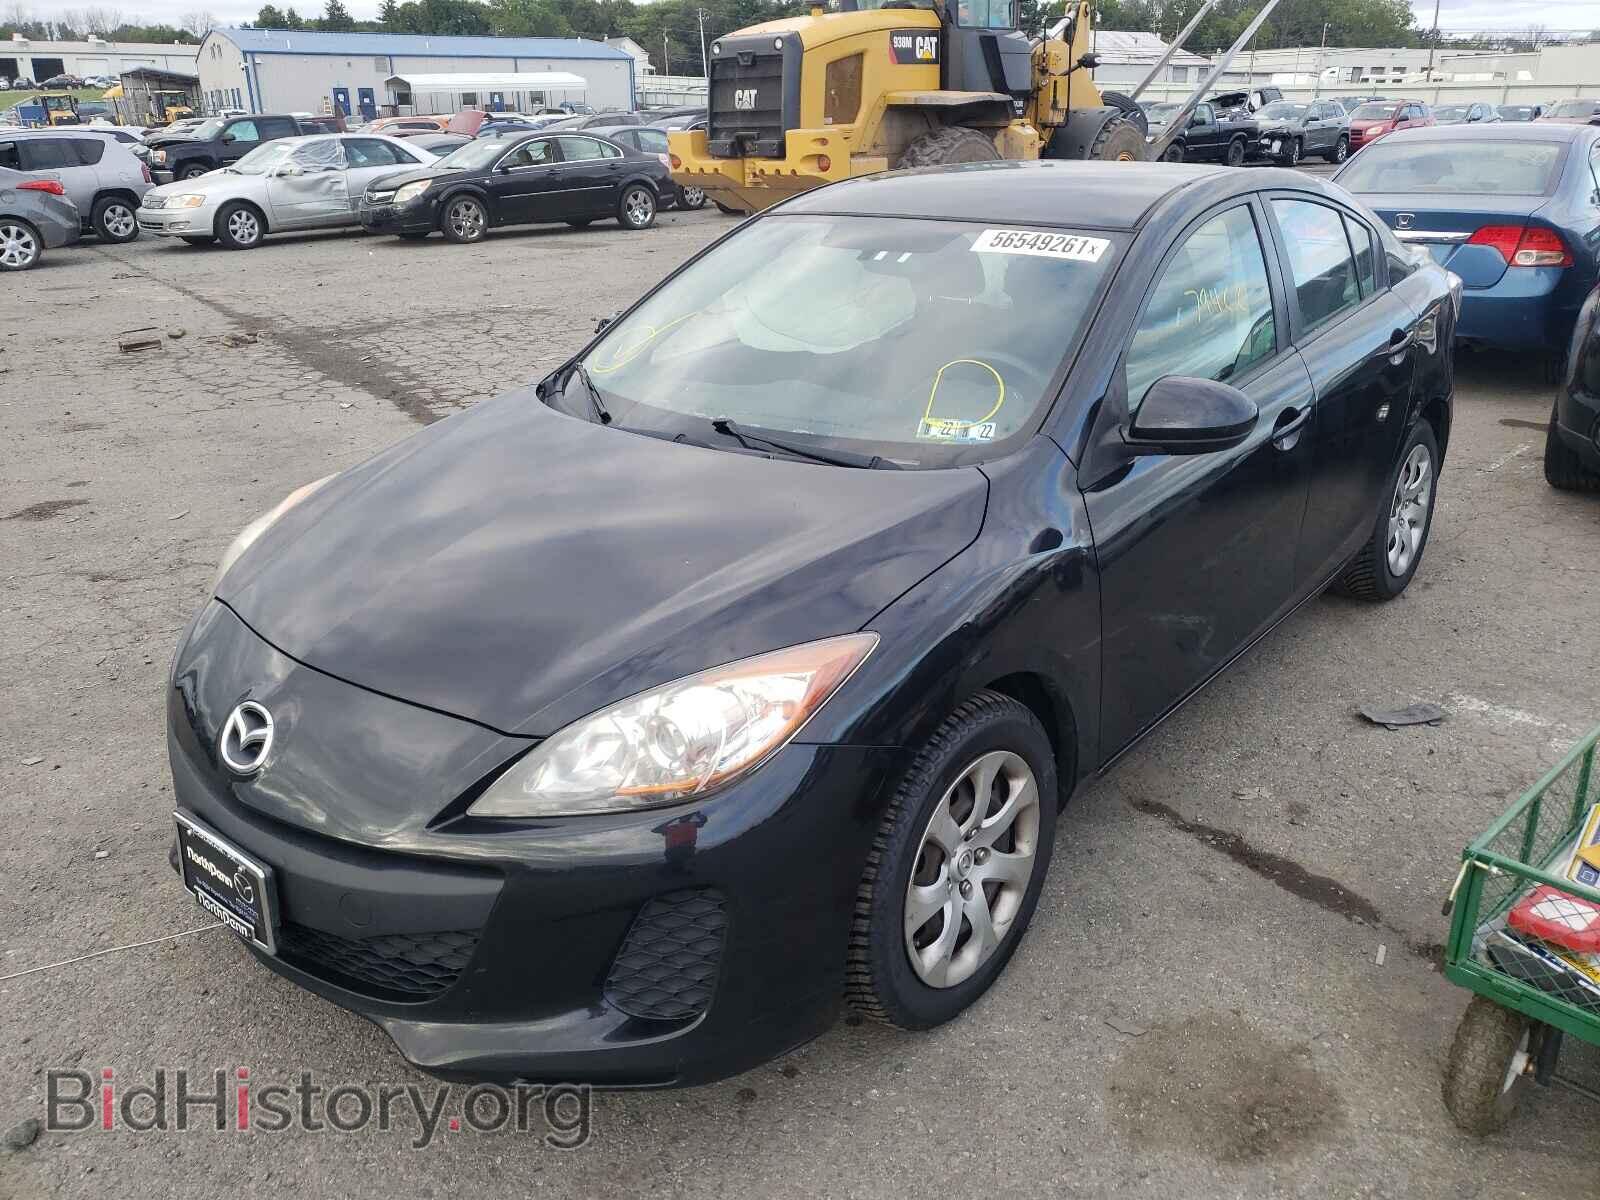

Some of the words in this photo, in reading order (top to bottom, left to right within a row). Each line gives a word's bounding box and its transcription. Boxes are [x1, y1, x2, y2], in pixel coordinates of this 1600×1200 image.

[915, 36, 937, 59] CAT
[734, 89, 758, 110] CAT
[980, 424, 993, 439] 22
